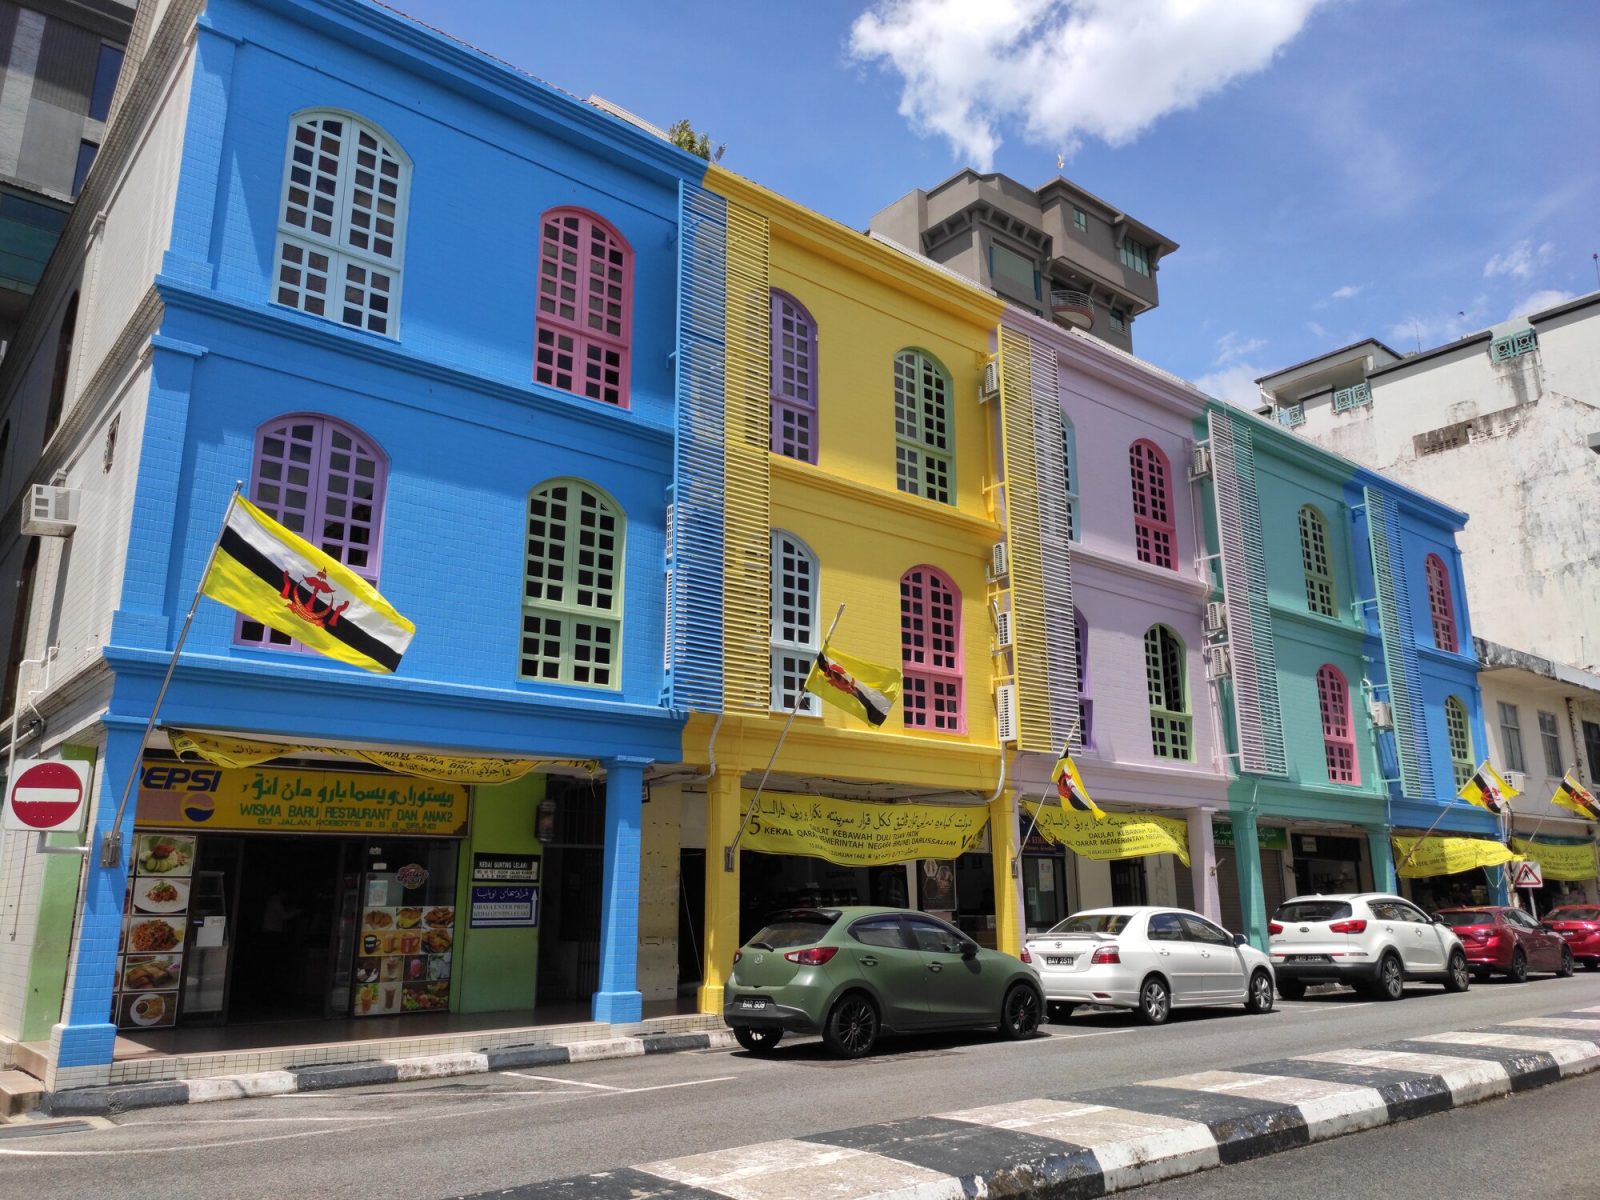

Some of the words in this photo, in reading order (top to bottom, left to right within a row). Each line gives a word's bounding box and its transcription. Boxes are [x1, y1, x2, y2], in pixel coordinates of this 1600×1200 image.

[140, 766, 223, 793] EPSI
[240, 803, 281, 817] WISMA
[288, 805, 319, 818] BARU
[325, 806, 392, 820] RESTAURANT
[397, 809, 418, 821] DAN
[423, 810, 453, 823] ANAK2
[278, 818, 311, 826] JALAN
[764, 826, 794, 836] KEKAL
[911, 837, 957, 846] DARUSSALAM
[832, 828, 873, 841] KEBAWAH
[1100, 835, 1145, 845] MEMERINTAH
